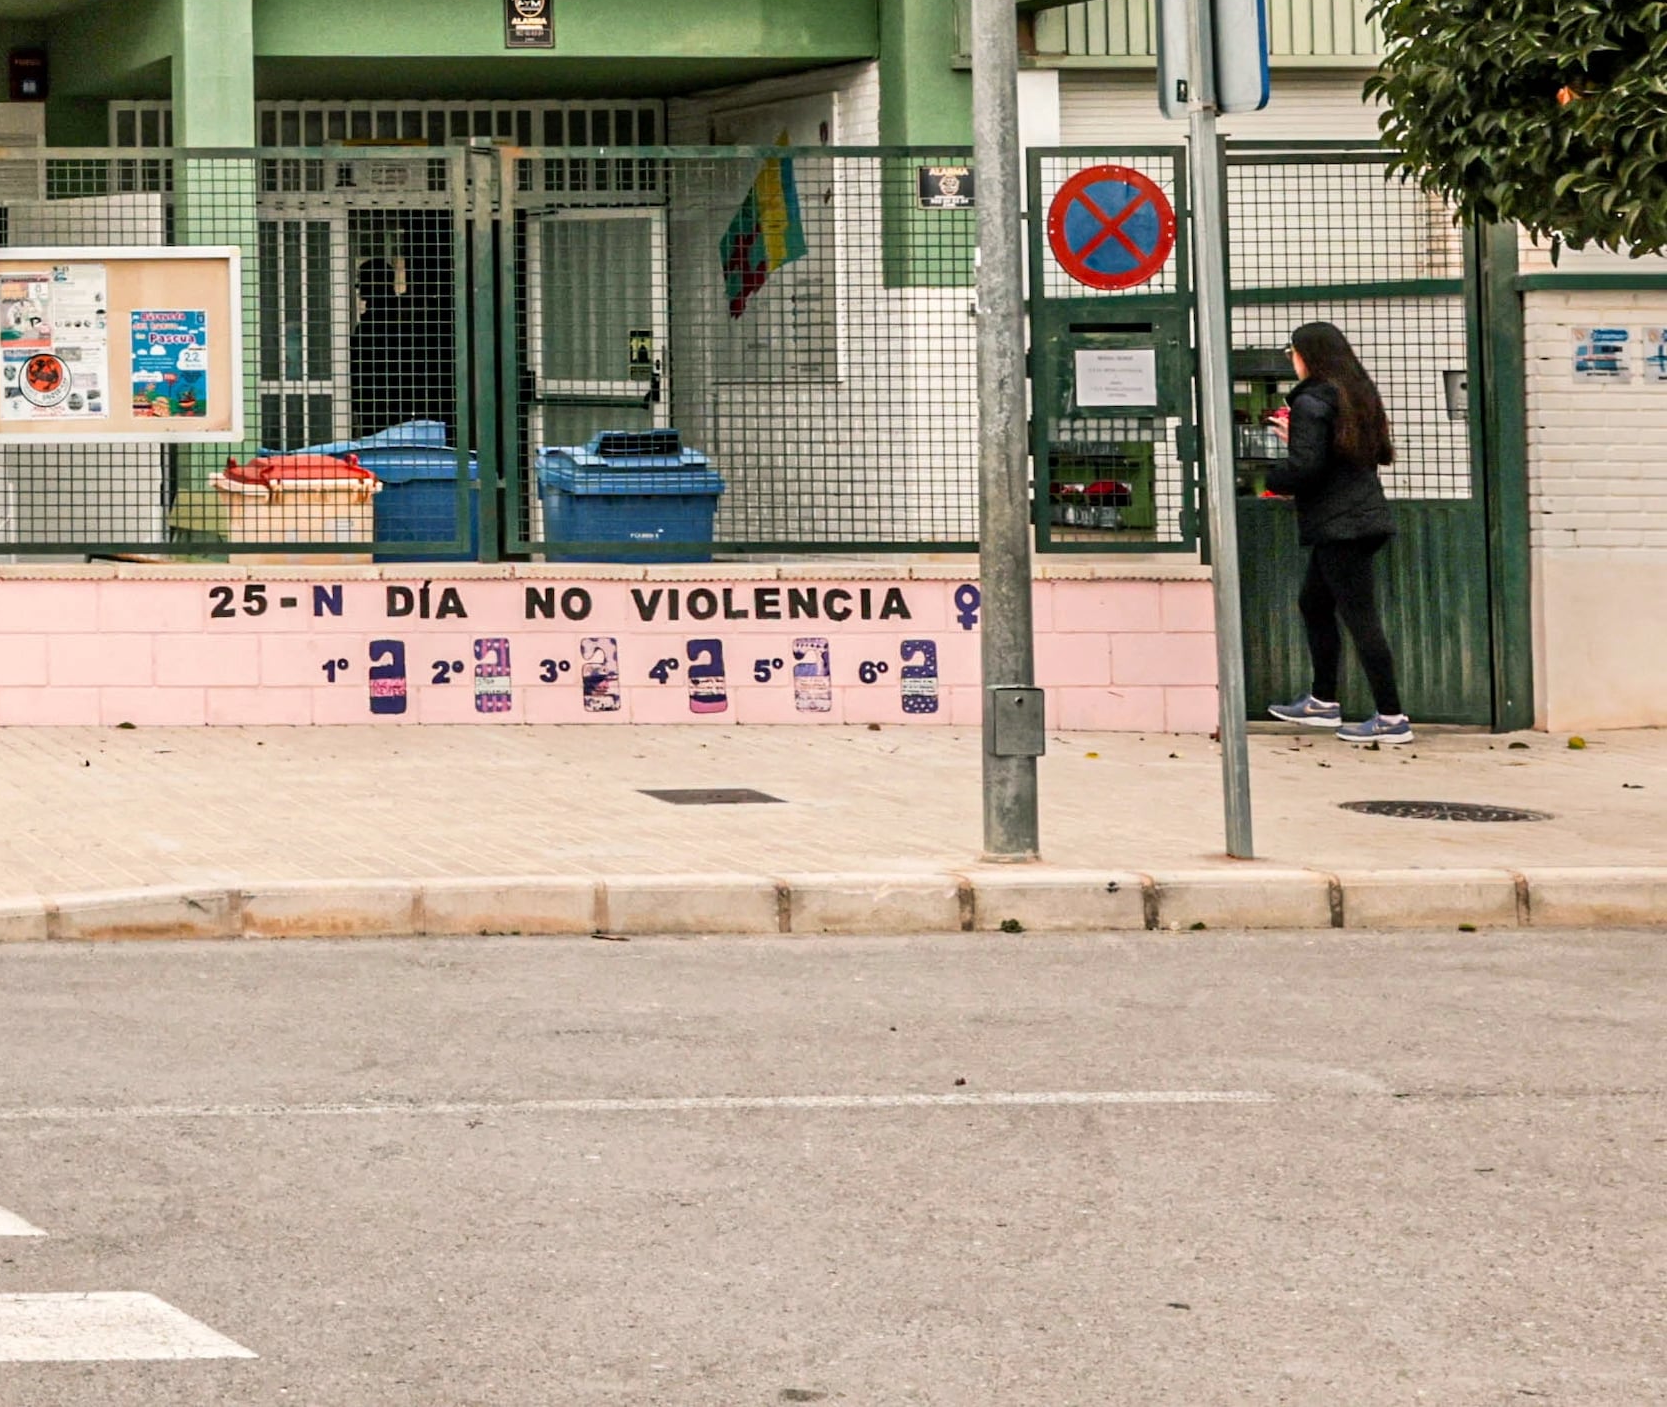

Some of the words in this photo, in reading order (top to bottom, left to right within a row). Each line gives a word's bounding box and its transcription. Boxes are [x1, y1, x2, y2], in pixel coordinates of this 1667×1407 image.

[150, 333, 195, 344] Pascua
[386, 580, 468, 619] DÍA
[525, 586, 592, 621] NO
[631, 587, 913, 622] VIOLENCIA
